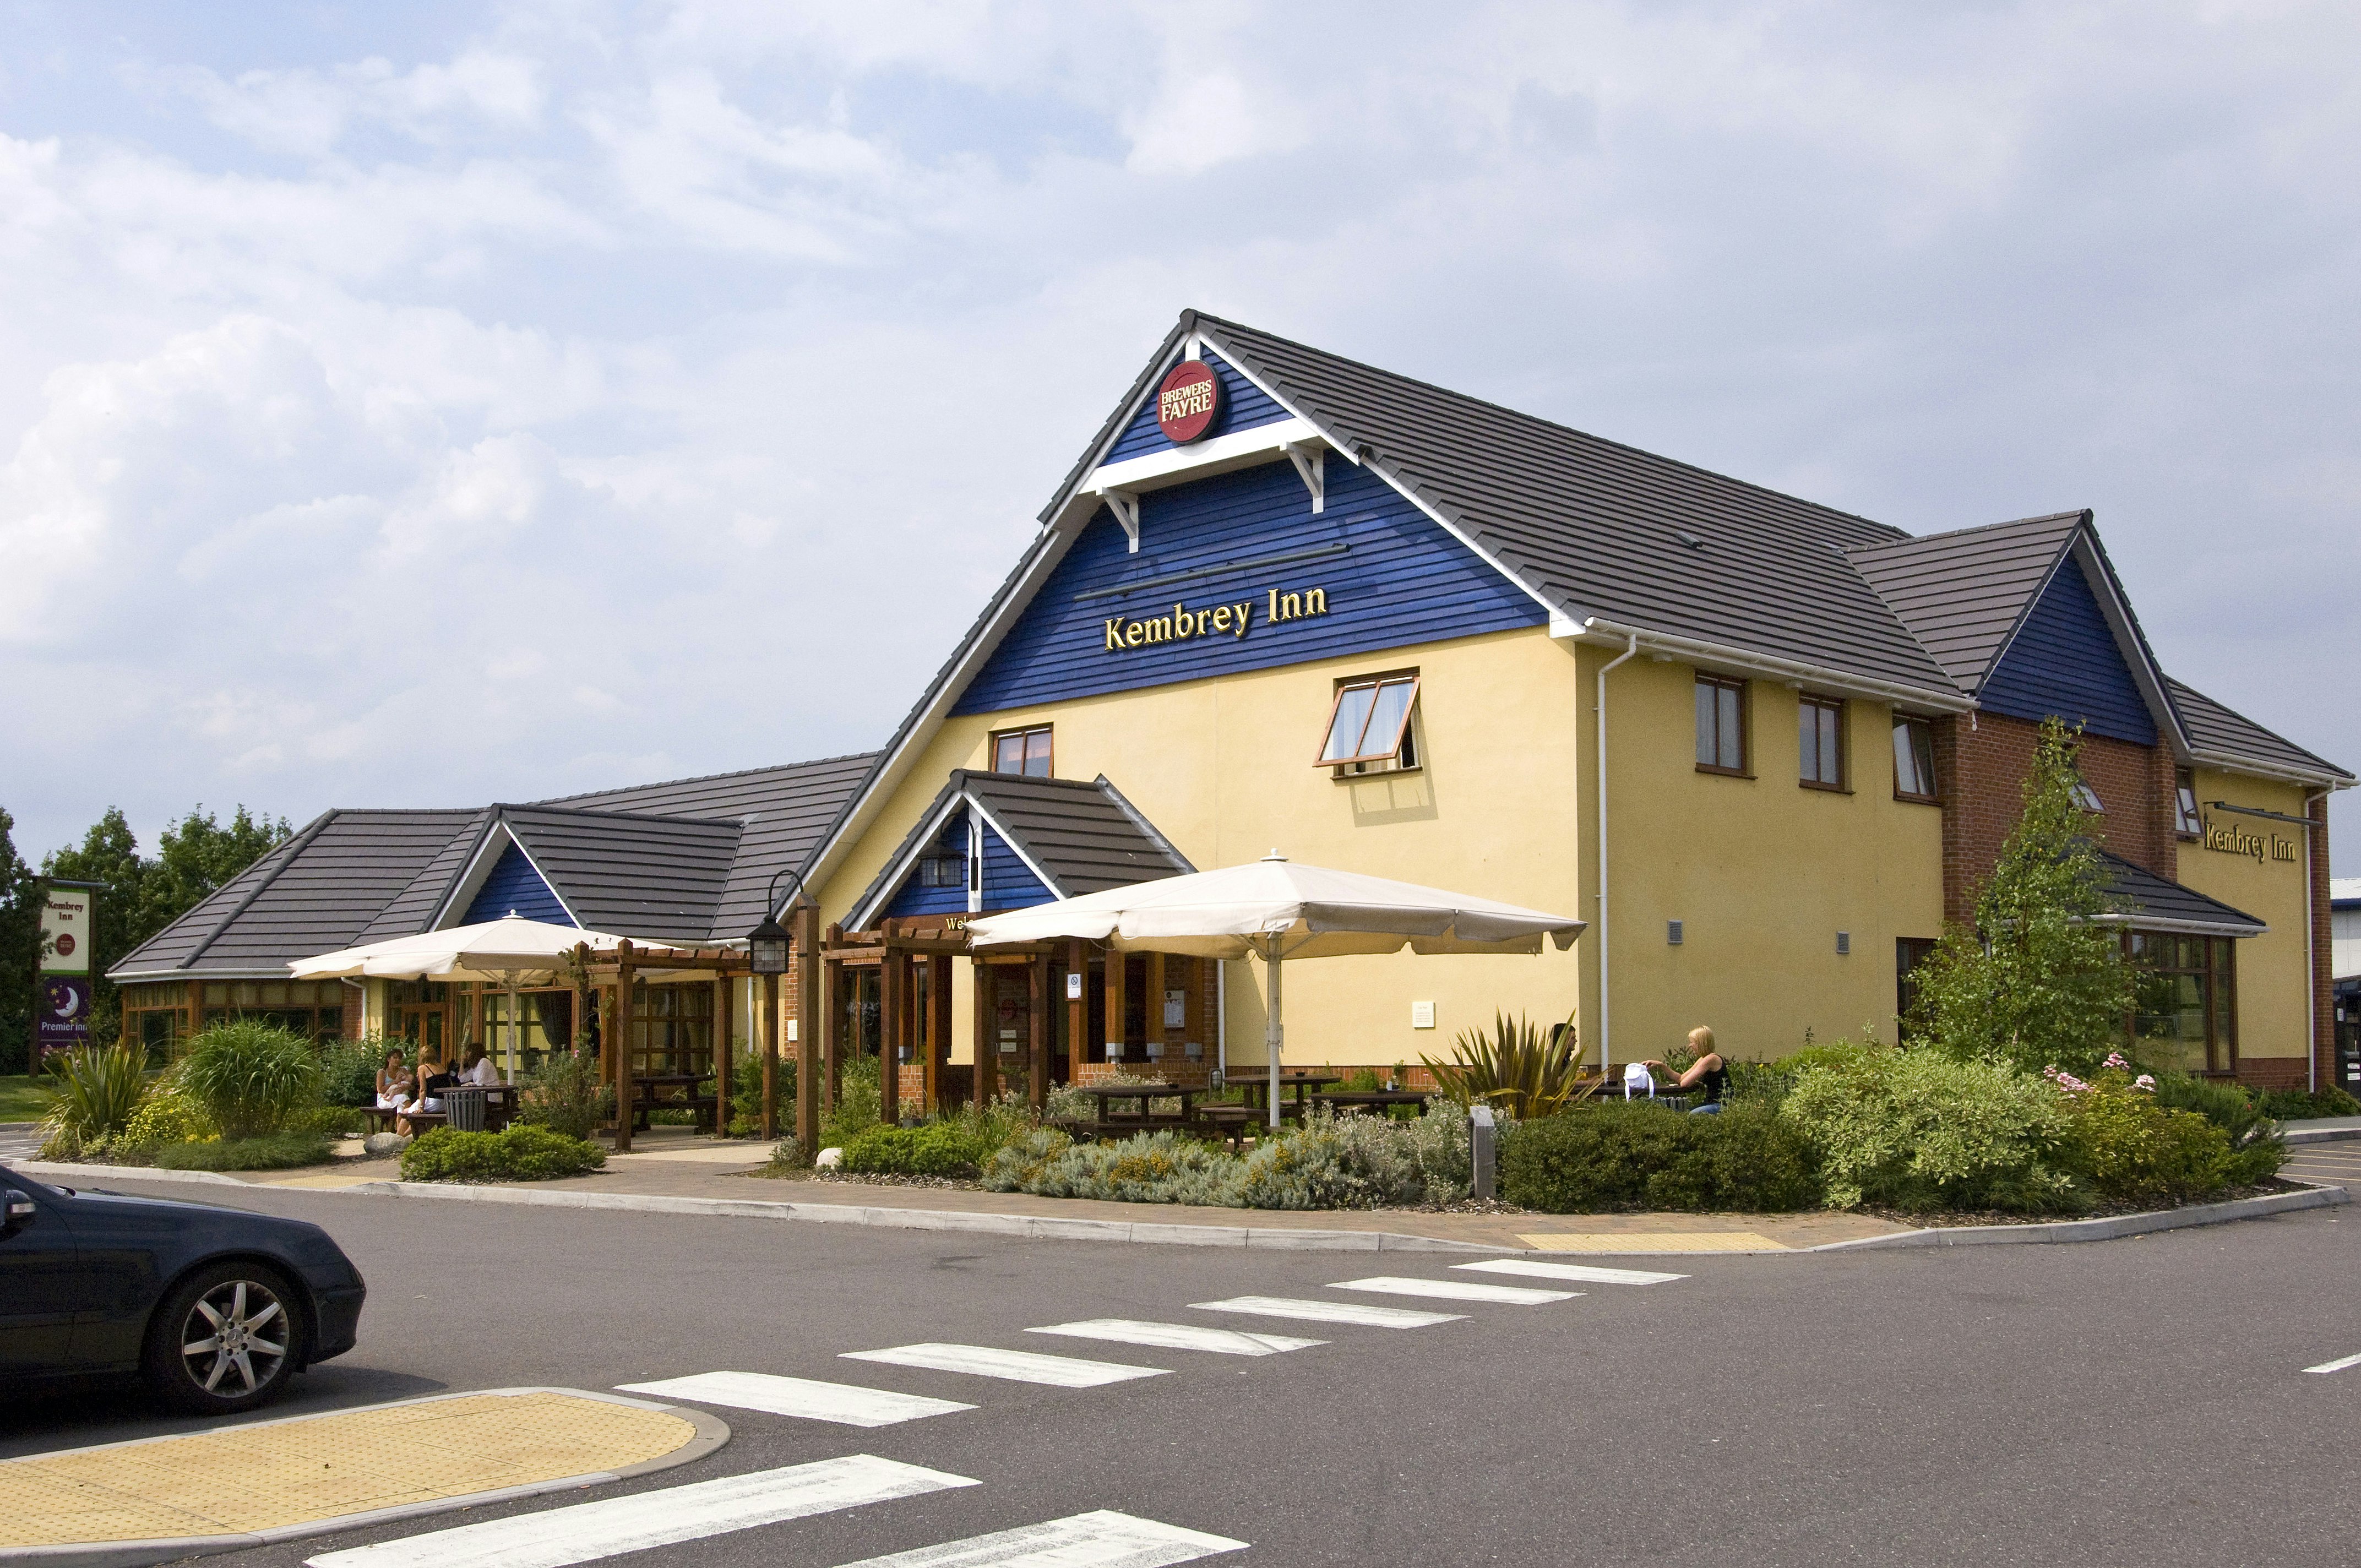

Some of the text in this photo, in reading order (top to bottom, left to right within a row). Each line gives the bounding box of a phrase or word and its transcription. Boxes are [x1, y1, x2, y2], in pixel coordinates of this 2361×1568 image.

[1161, 379, 1211, 405] BREWERS
[1161, 393, 1211, 422] FAYRE
[1105, 587, 1327, 651] Kembrey Inn
[2205, 823, 2295, 863] Kembrey Inn
[48, 901, 84, 912] Kembrey
[59, 912, 73, 921] Inn
[42, 1022, 74, 1031] Premier
